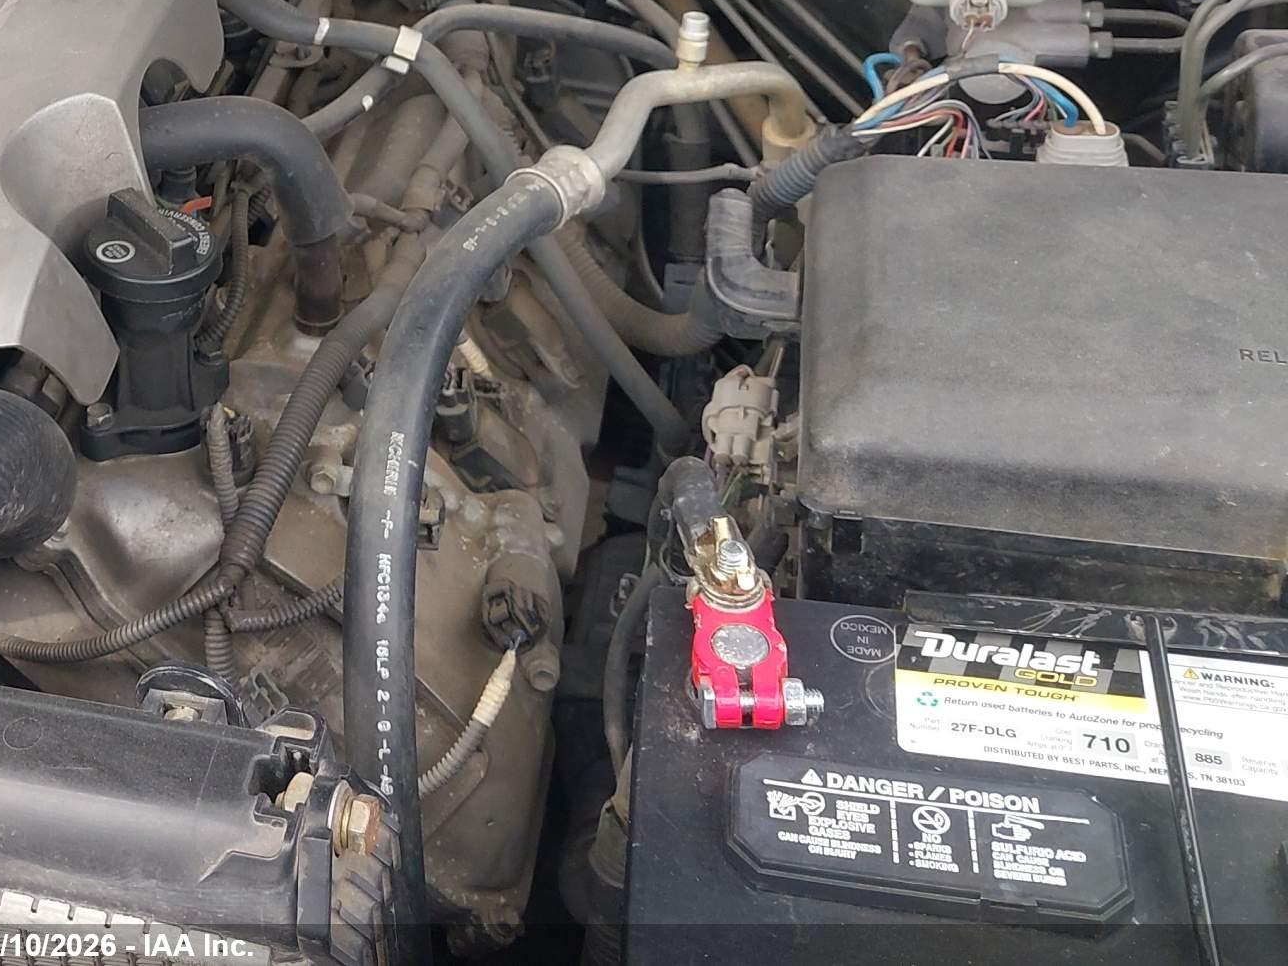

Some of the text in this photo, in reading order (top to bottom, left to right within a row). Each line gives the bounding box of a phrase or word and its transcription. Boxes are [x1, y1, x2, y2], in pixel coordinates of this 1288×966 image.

[839, 621, 888, 635] MEXICO
[856, 634, 869, 645] IN
[846, 645, 882, 658] MADE
[914, 631, 1101, 677] Duralast
[1013, 668, 1098, 687] GOLD
[1200, 672, 1275, 689] WARNING:
[933, 677, 1077, 702] PROVEN TOUGH
[944, 696, 979, 707] Return
[981, 701, 1006, 711] used
[1008, 704, 1053, 718] batteries
[1056, 710, 1066, 719] to
[1069, 712, 1119, 726] AutoZone
[1122, 717, 1137, 727] for
[1178, 725, 1224, 739] ecycling
[950, 722, 1017, 738] 27F-DLG
[1082, 733, 1131, 754] 710
[983, 745, 1045, 760] DISTRIBUTED
[1047, 754, 1059, 762] BY
[1062, 756, 1085, 767] BEST
[1201, 773, 1213, 782] TN
[1194, 752, 1224, 766] 885
[826, 772, 924, 800] DANGER
[949, 788, 1041, 815] POISON
[835, 799, 881, 815] SHIELD
[808, 815, 876, 834] EXPLOSIVE
[836, 810, 870, 823] EYES
[808, 825, 851, 841] GASES
[922, 833, 942, 844] NO
[991, 841, 1087, 863] SULFURIC ACID
